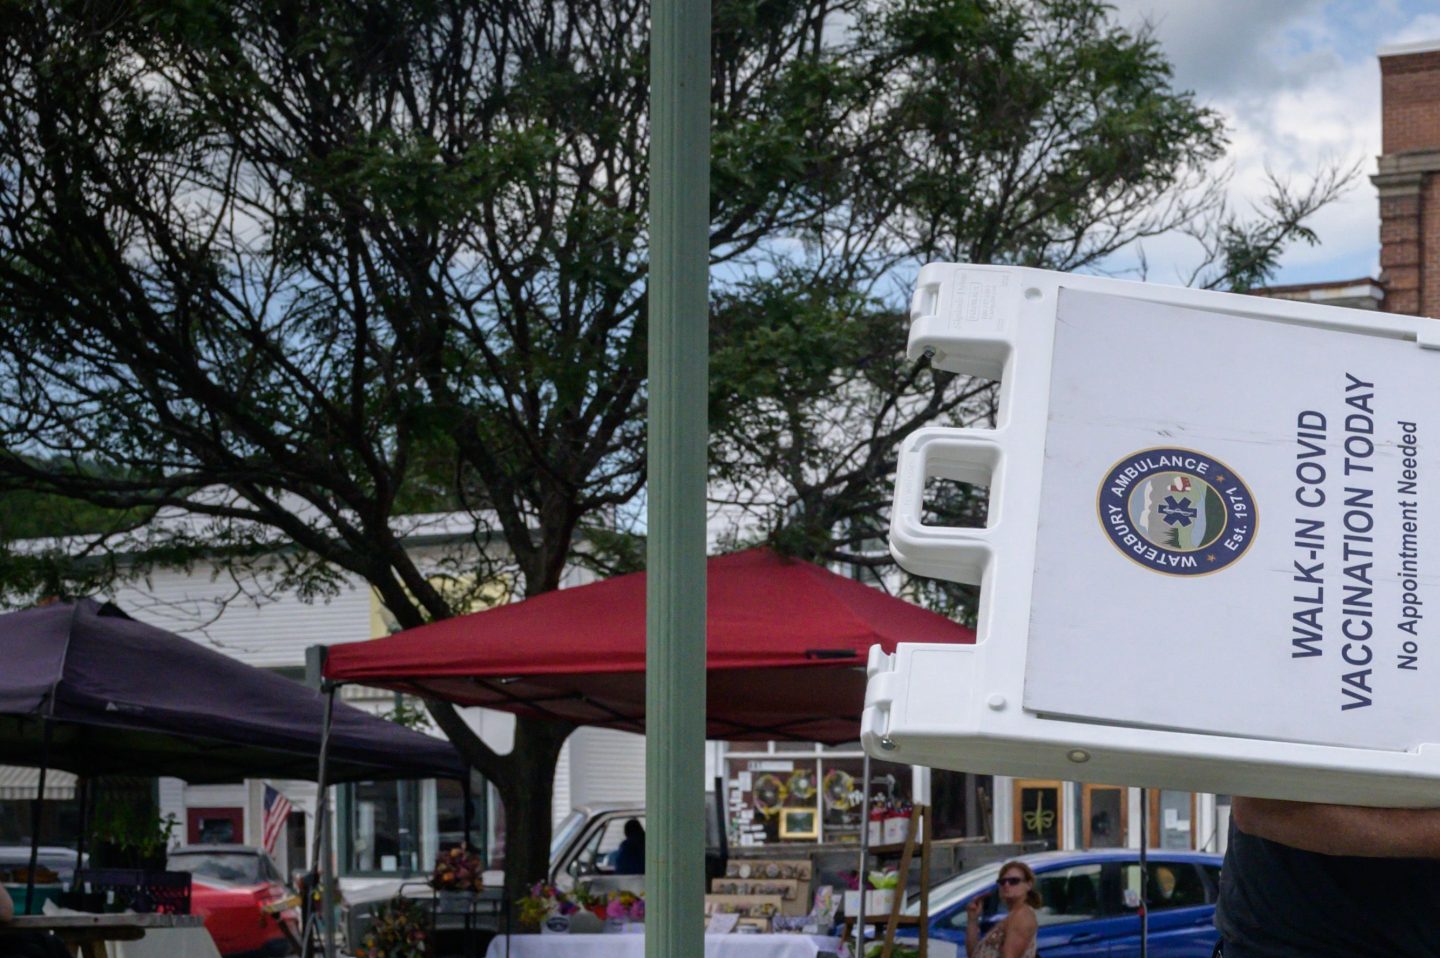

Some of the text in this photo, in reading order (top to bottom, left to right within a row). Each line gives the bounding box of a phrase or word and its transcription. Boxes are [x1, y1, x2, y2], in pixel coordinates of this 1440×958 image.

[1108, 455, 1210, 568] WATERBURY AMBULANCE
[1224, 486, 1248, 551] Est. 1971
[1291, 410, 1327, 659] WALK-IN COVID
[1341, 372, 1375, 711] VACCINATION TODAY
[1397, 420, 1423, 671] No Appointment Needed
